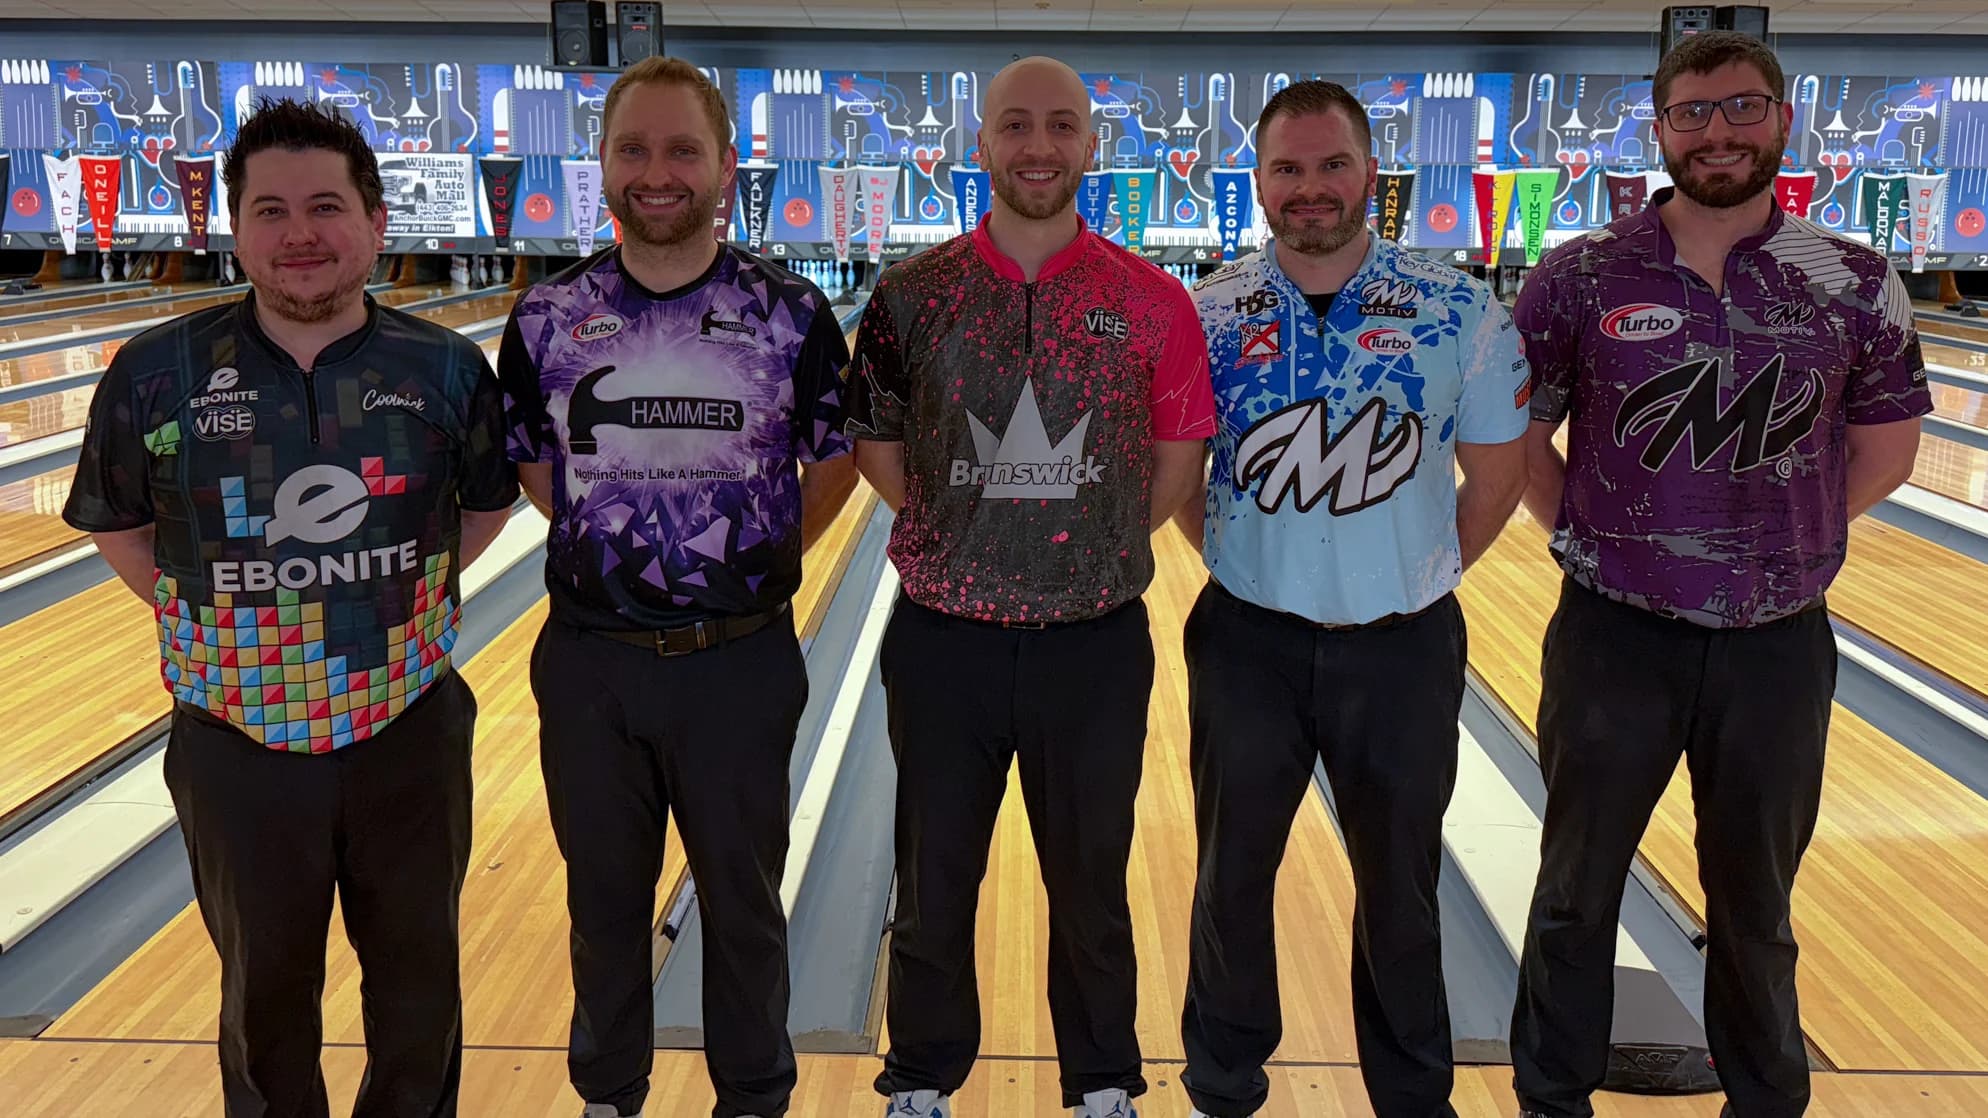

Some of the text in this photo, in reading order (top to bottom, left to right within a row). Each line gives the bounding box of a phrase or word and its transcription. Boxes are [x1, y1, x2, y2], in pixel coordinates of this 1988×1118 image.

[406, 157, 464, 168] Williams
[420, 169, 464, 180] Family
[435, 180, 465, 189] Auto
[57, 172, 75, 234] FACH
[94, 164, 108, 241] ONEILL
[436, 191, 465, 201] Mall
[495, 175, 508, 237] JONES
[577, 171, 592, 248] PRATHER
[749, 172, 763, 248] FAULKNER
[833, 175, 846, 257] DAUGHERTY
[869, 192, 884, 253] MOORE
[1224, 181, 1238, 252] AZCONA
[1528, 183, 1542, 256] SIMONSEN
[1913, 189, 1932, 256] RUSSO
[3, 234, 12, 246] 7
[174, 236, 183, 248] 8
[425, 238, 439, 250] 10
[514, 240, 526, 252] 11
[772, 244, 786, 256] 13
[1193, 248, 1207, 260] 16
[1454, 250, 1468, 262] 18
[1361, 306, 1414, 317] MOTIV
[579, 319, 617, 336] Turbo
[1615, 314, 1675, 332] Turbo
[1371, 336, 1412, 350] Turbo
[190, 391, 258, 409] EBONITE
[631, 401, 737, 427] HAMMER
[574, 467, 617, 481] Nothing
[620, 469, 644, 480] Hits
[649, 468, 675, 480] Like
[678, 469, 687, 479] A
[950, 455, 1107, 487] Brunswick
[212, 539, 417, 592] EBONITE
